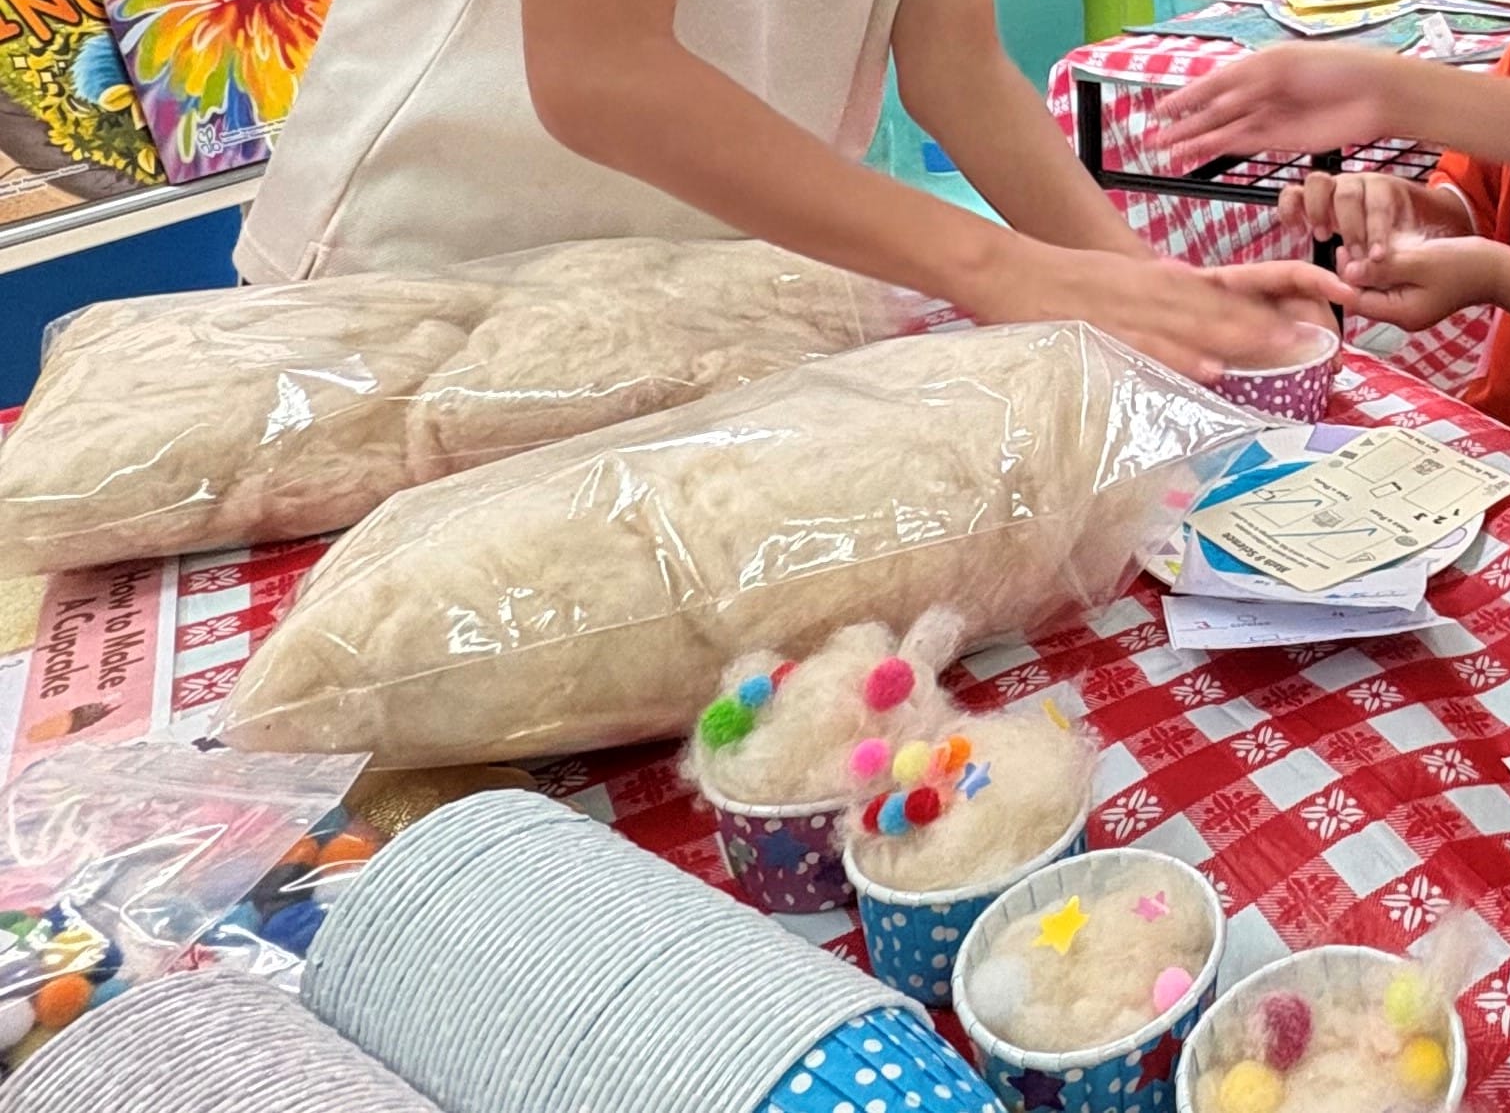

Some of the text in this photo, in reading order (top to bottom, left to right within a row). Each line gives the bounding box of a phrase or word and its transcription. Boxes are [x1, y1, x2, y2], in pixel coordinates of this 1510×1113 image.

[1221, 531, 1260, 558] Science
[1433, 515, 1449, 525] 2
[36, 596, 98, 700] A Cupcake
[96, 567, 153, 691] How to Make
